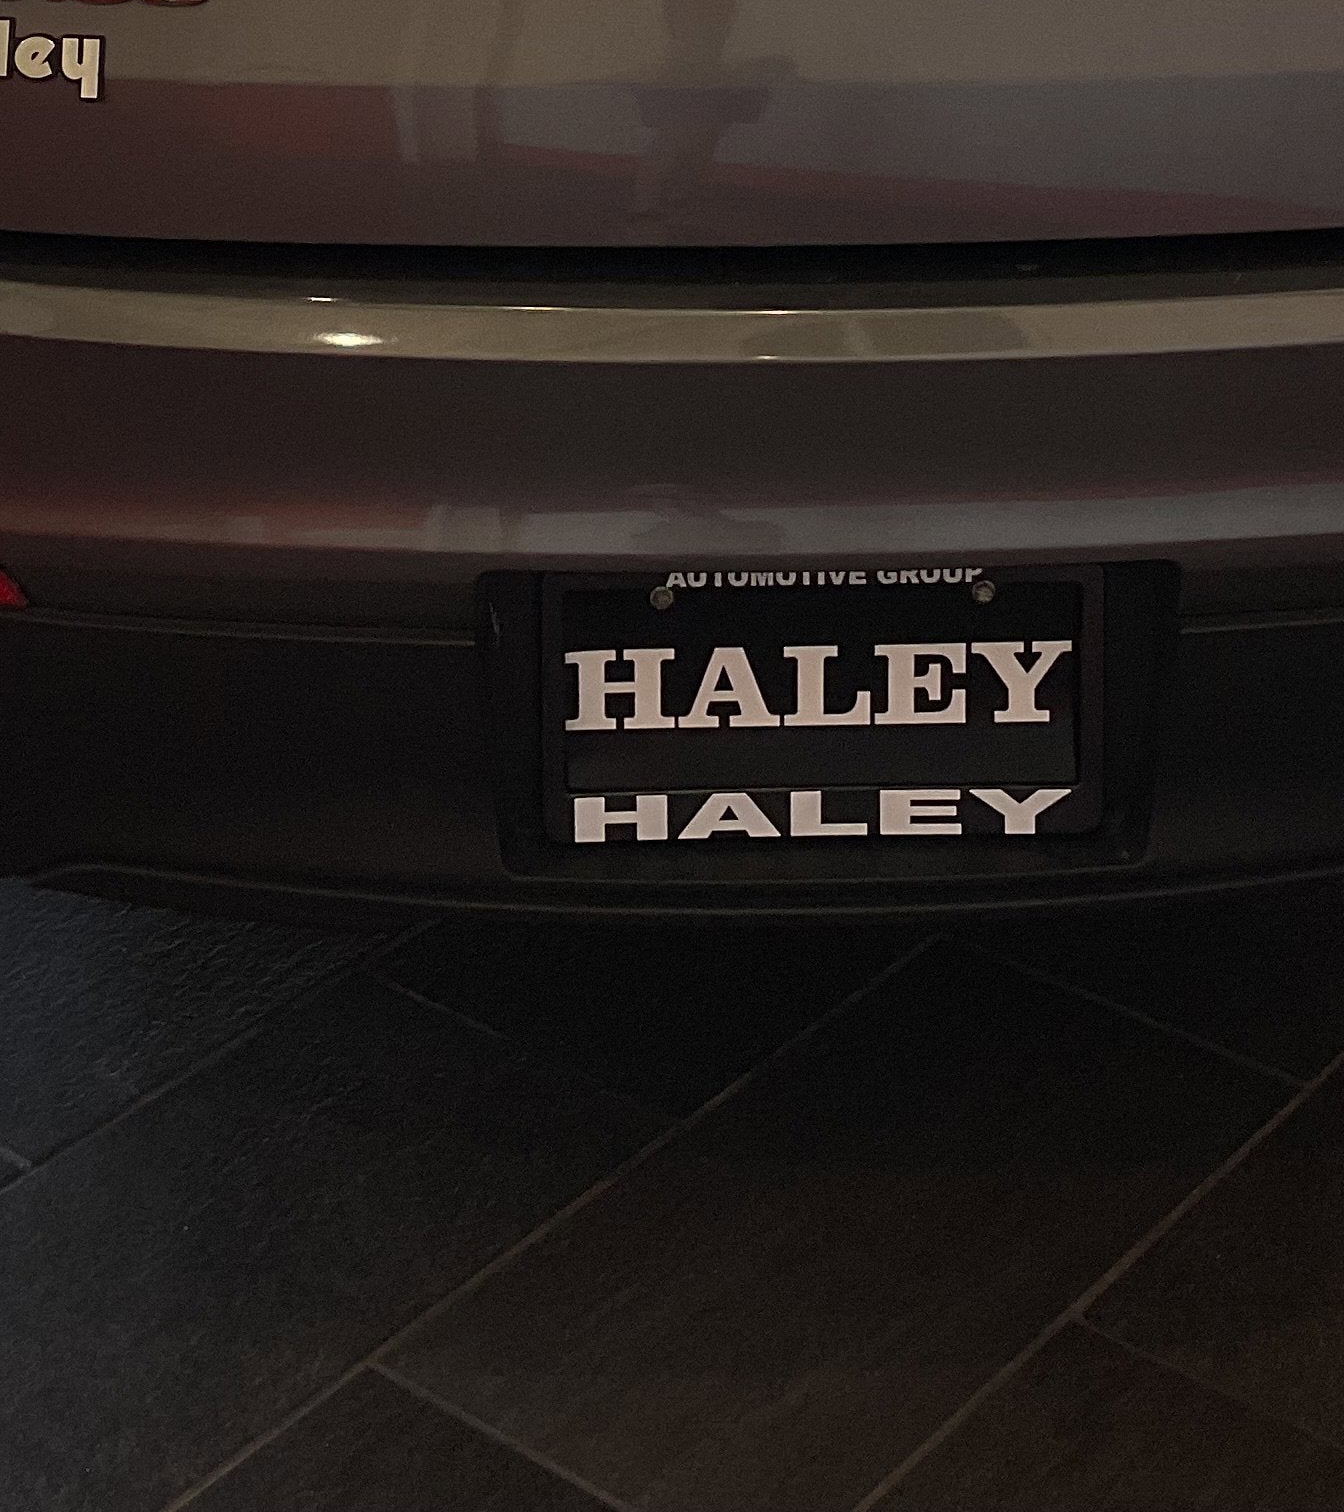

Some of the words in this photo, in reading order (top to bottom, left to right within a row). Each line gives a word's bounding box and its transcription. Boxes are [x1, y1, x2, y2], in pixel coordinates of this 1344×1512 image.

[666, 571, 867, 588] AUTOMOTIVE
[877, 567, 983, 585] GROUP
[564, 639, 1072, 731] HALEY
[573, 788, 1072, 843] HALEY
